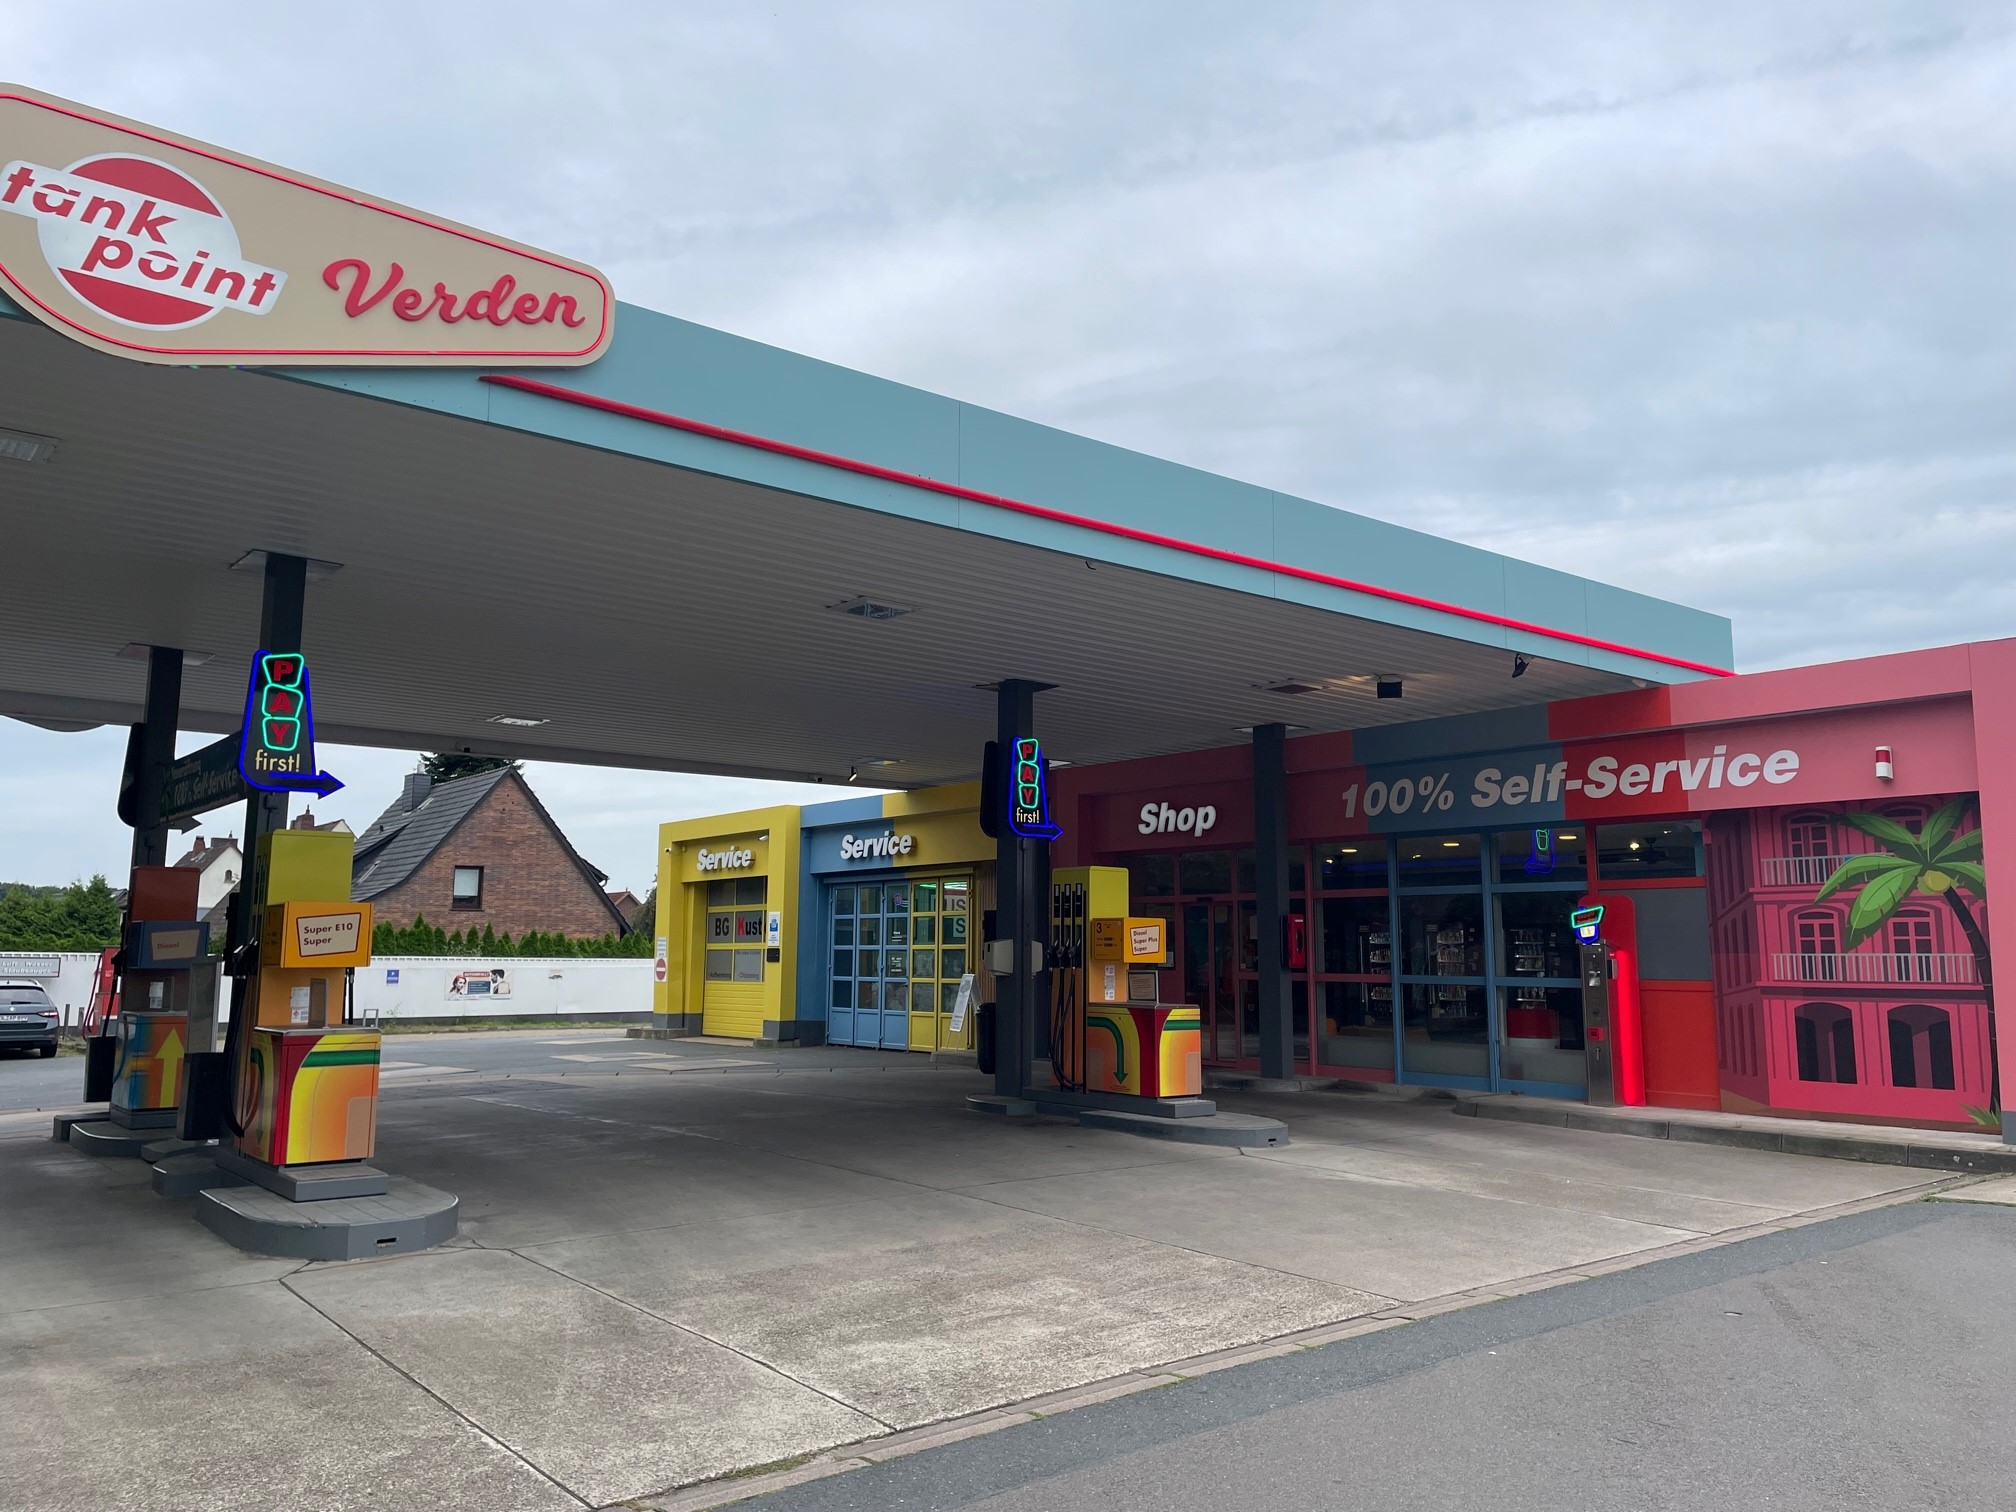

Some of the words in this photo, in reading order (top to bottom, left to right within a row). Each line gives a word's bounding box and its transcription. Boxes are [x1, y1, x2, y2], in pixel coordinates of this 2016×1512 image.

[1, 165, 178, 246] tank
[80, 235, 277, 308] point
[322, 258, 586, 329] Verden
[270, 660, 294, 745] PAY
[255, 749, 301, 772] first!
[1022, 743, 1035, 804] PAY
[1342, 772, 1455, 818] 100%
[1471, 745, 1800, 809] Self-Service
[1016, 807, 1040, 823] first!
[1138, 802, 1217, 837] Shop
[697, 845, 752, 871] Service
[840, 830, 913, 860] Service
[303, 925, 333, 935] Super
[335, 922, 353, 932] E10
[714, 917, 730, 936] BG
[737, 916, 766, 937] Kust
[1096, 922, 1102, 934] 3
[303, 937, 332, 947] Super
